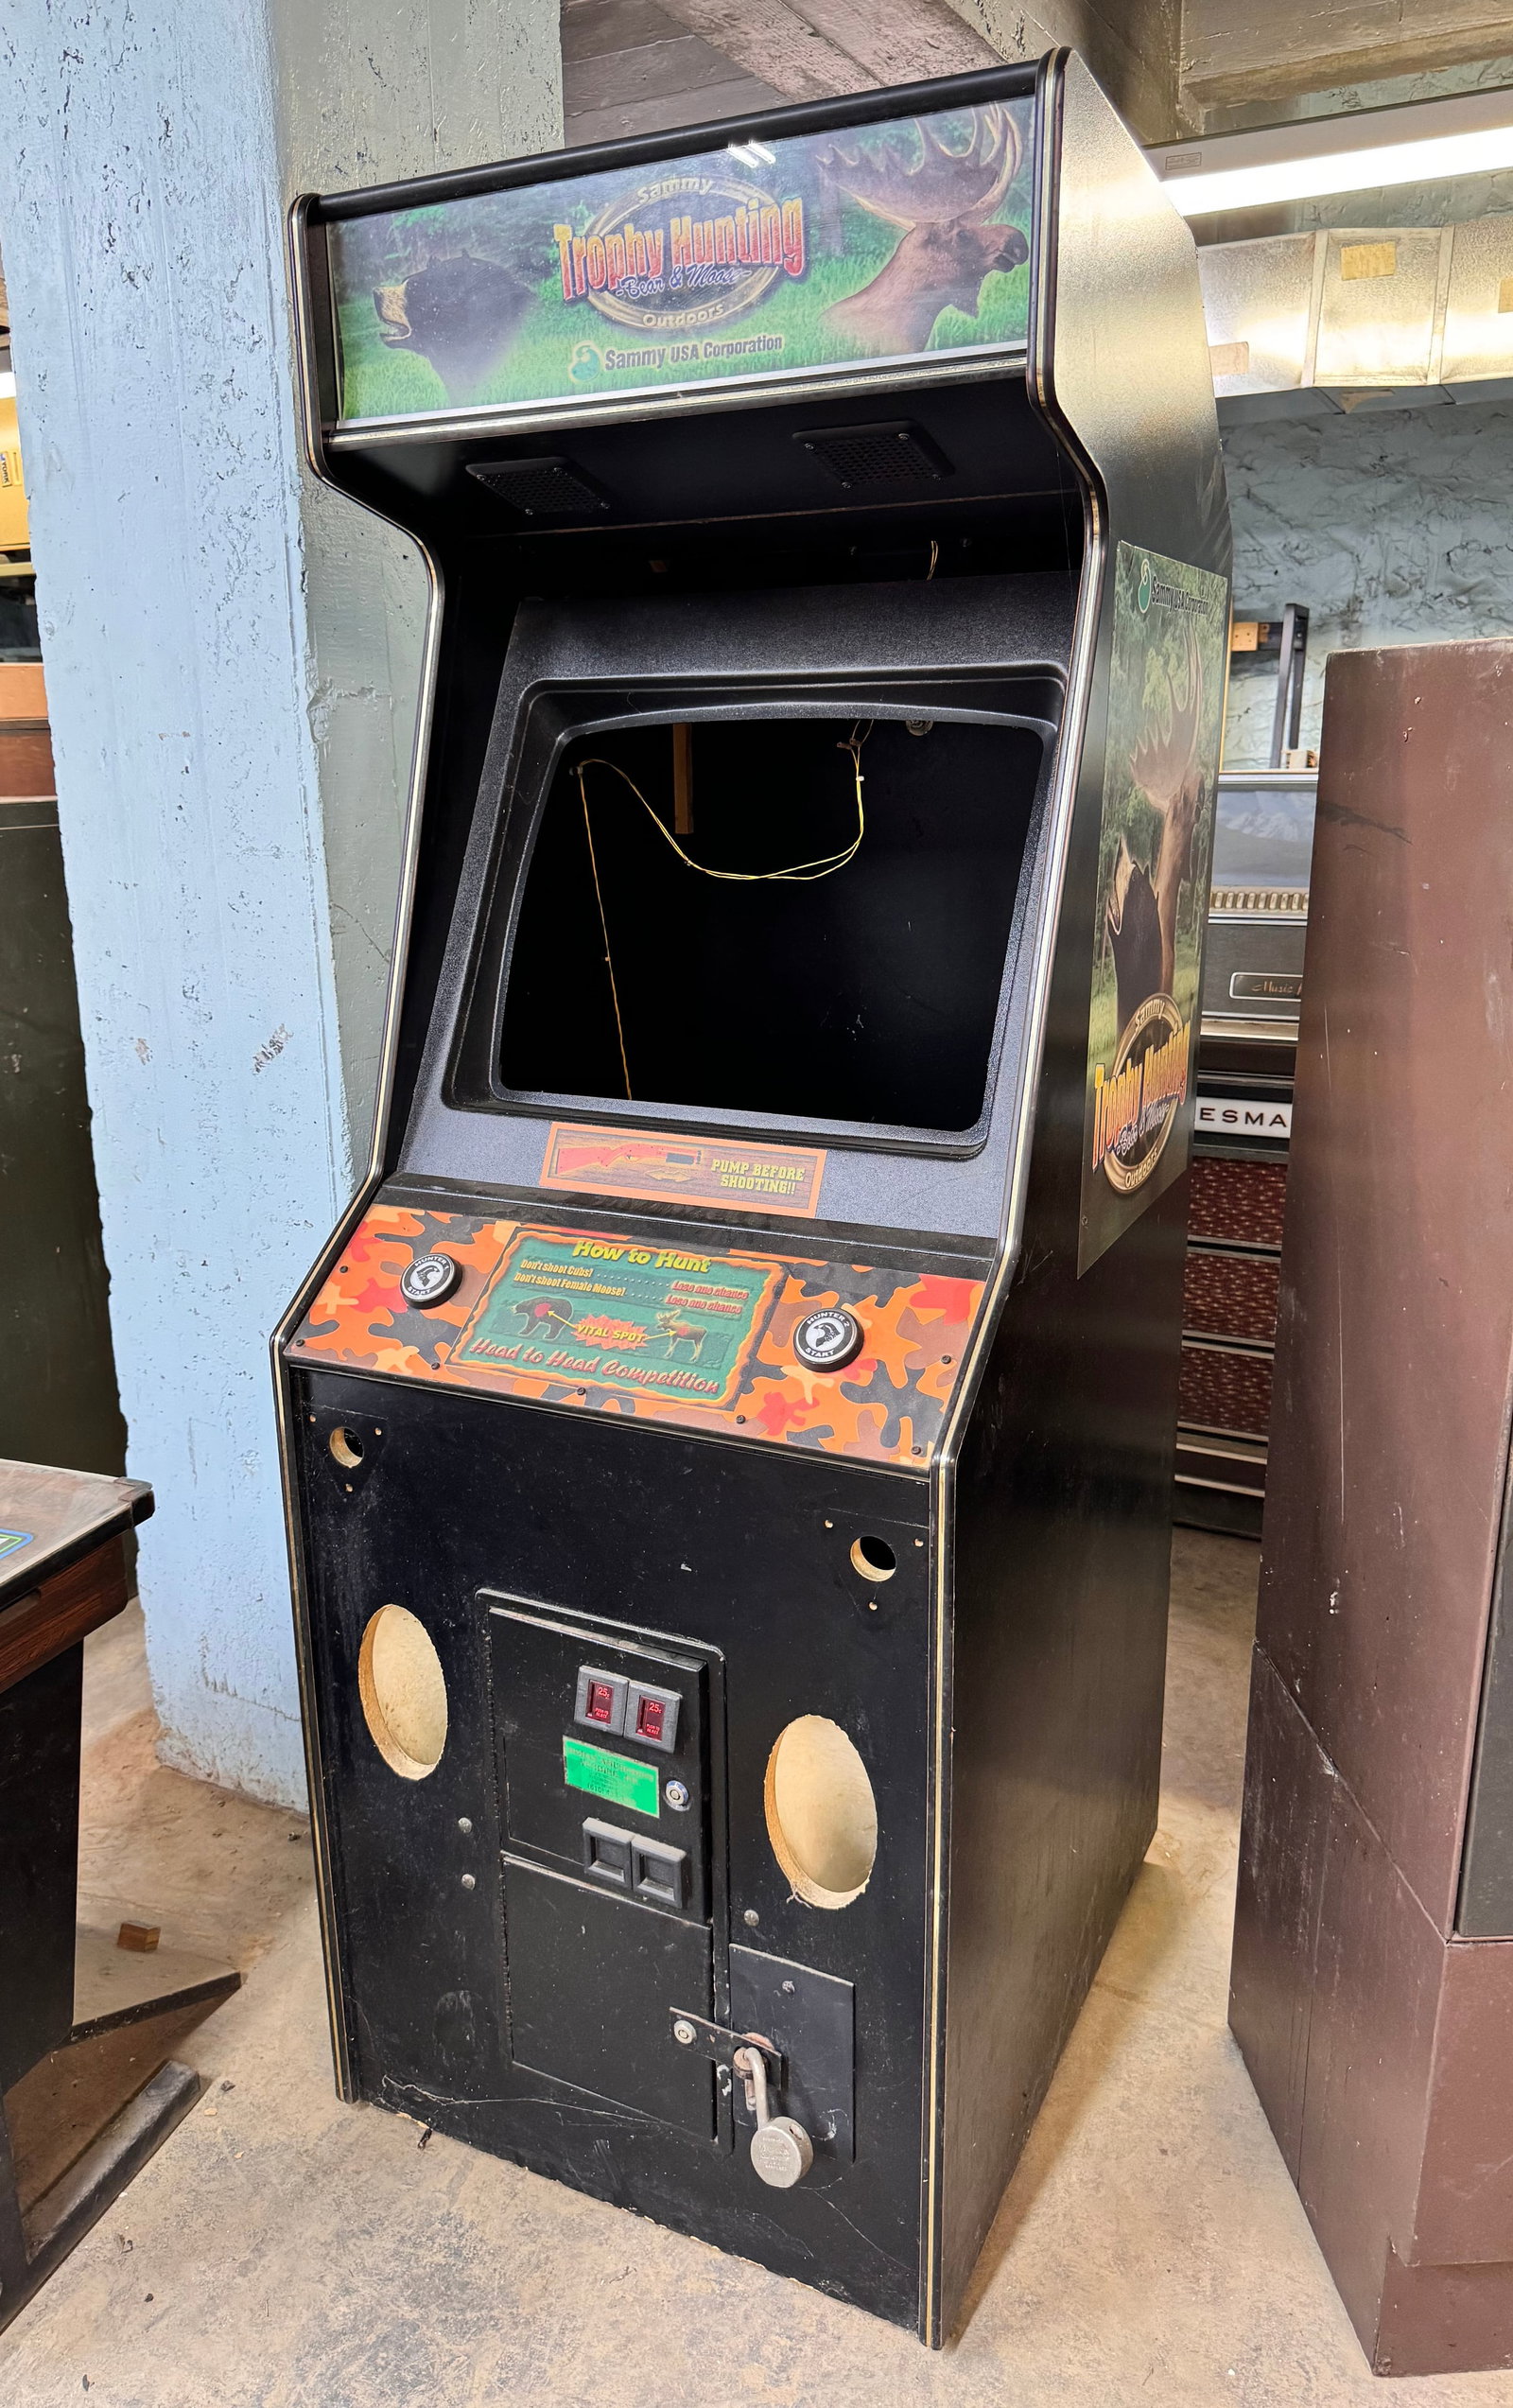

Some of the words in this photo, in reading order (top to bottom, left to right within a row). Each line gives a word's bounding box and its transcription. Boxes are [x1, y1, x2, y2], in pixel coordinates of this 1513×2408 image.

[637, 175, 716, 204] Sammy
[553, 222, 664, 301] Trophy
[670, 197, 805, 277] Hunting
[670, 265, 683, 289] &
[643, 303, 724, 328] Outdoors
[604, 345, 666, 371] Sammy
[670, 343, 699, 362] USA
[704, 335, 782, 358] Corporation
[1152, 575, 1174, 613] Sammy
[711, 1160, 749, 1176] PUMP
[753, 1163, 805, 1181] BEFORE
[1125, 1147, 1157, 1188] Outdoors
[721, 1175, 796, 1195] SHOOTING!!
[414, 1256, 447, 1266] HUNTER
[520, 1259, 543, 1270] Don't
[542, 1263, 567, 1274] shoot
[567, 1266, 595, 1277] Cubs!
[571, 1241, 624, 1262] How
[626, 1248, 651, 1265] to
[653, 1252, 712, 1273] Hunt
[407, 1286, 431, 1295] START
[513, 1272, 536, 1283] Don't
[535, 1275, 562, 1286] shoot
[561, 1279, 593, 1292] Female
[592, 1283, 627, 1297] Moose!
[807, 1312, 845, 1324] HUNTER
[576, 1324, 608, 1338] VITAL
[613, 1330, 645, 1343] SPOT
[805, 1348, 834, 1357] START
[469, 1336, 522, 1359] Head
[522, 1346, 545, 1364] to
[546, 1351, 600, 1373] Head
[600, 1359, 720, 1394] Competition
